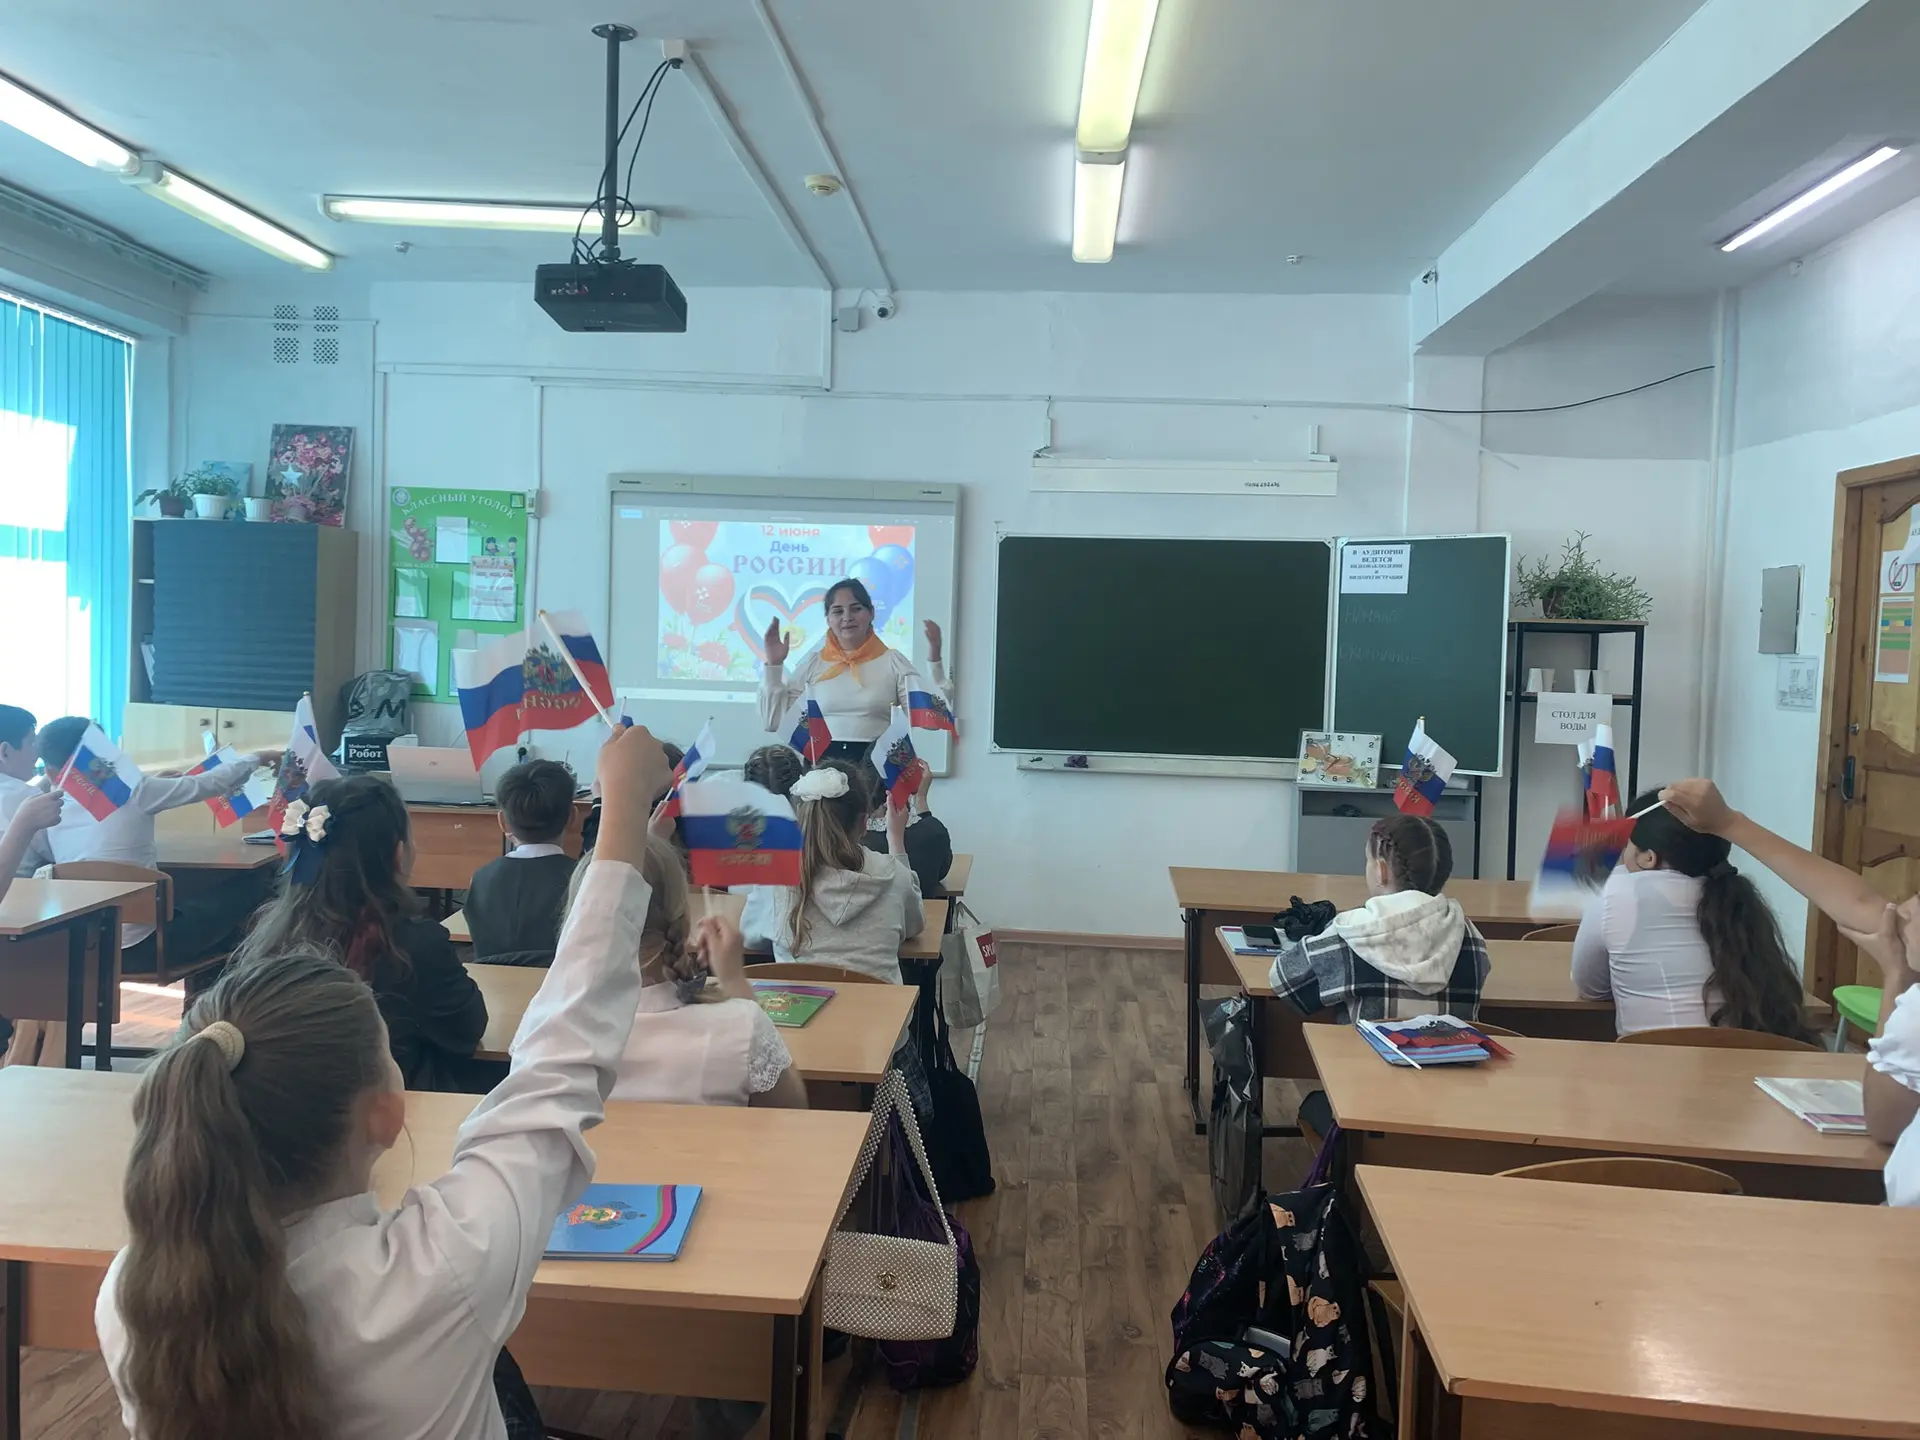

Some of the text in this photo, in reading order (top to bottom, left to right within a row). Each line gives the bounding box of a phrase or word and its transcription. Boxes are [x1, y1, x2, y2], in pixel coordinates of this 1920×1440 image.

[401, 491, 516, 519] КЛАССНЫЙ УГОЛОК
[761, 524, 820, 537] 12 июня
[769, 540, 810, 553] День
[732, 555, 848, 576] РОССИИ
[1551, 710, 1597, 720] СТОЛ ДЛЯ
[1560, 722, 1587, 731] ВОДЫ
[348, 748, 384, 759] Робот
